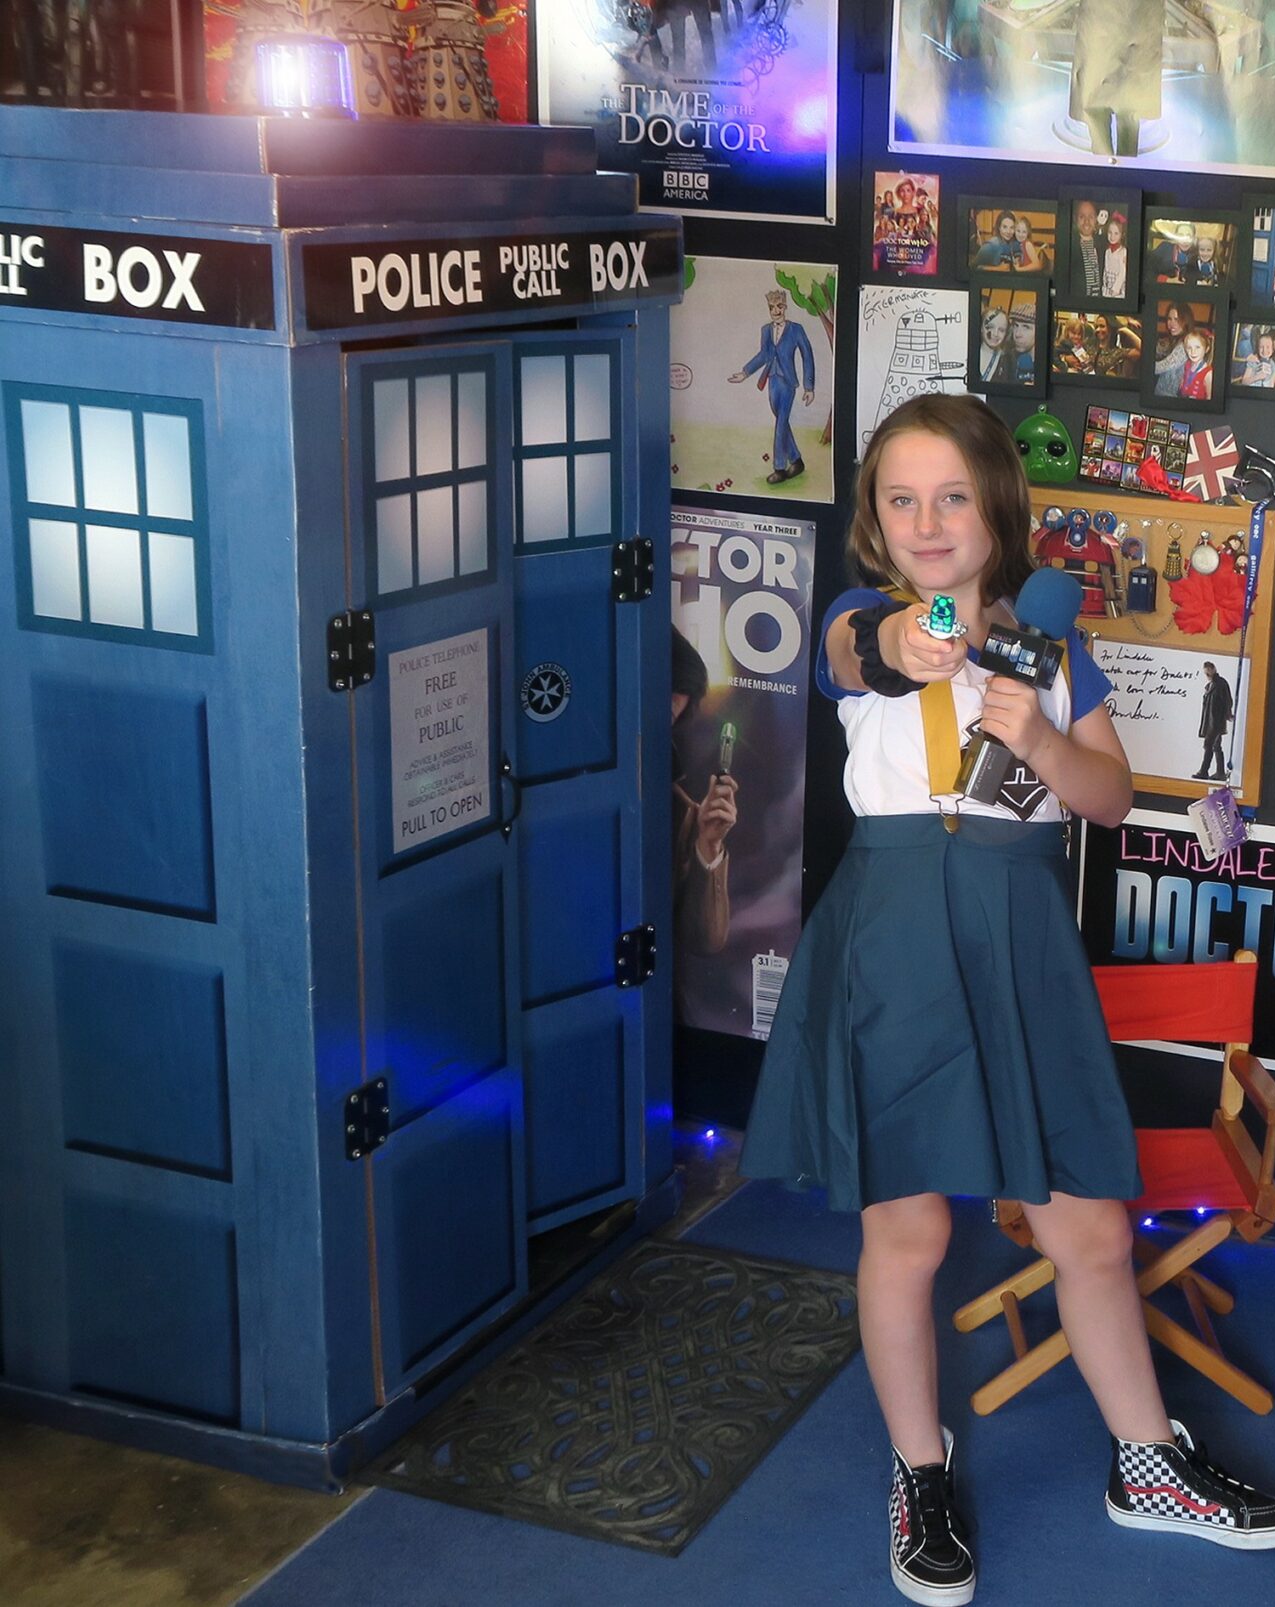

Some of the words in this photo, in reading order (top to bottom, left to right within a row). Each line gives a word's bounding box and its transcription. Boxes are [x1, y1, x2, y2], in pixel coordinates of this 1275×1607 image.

[602, 98, 624, 109] THE
[620, 83, 712, 120] TIME
[713, 103, 730, 115] OF
[732, 104, 756, 116] THE
[618, 113, 771, 153] DOCTOR
[664, 172, 708, 188] BBC
[663, 190, 708, 201] AMERICA
[499, 243, 570, 274] PUBLIC
[589, 241, 649, 292] BOX
[83, 243, 206, 312] BOX
[351, 250, 483, 314] POLICE
[513, 270, 562, 299] CALL
[699, 516, 745, 529] ADVENTURES
[753, 523, 774, 533] YEAR
[775, 526, 798, 536] THREE
[671, 581, 801, 690] HO
[400, 655, 430, 674] POLICE
[432, 641, 480, 664] TELEPHONE
[425, 671, 457, 695] FREE
[728, 676, 798, 695] REMEMBRANCE
[414, 706, 432, 720] FOR
[437, 698, 453, 712] USE
[457, 693, 469, 706] OF
[419, 714, 465, 743] PUBLIC
[409, 755, 432, 769] ADVICE
[402, 816, 427, 837] PULL
[430, 806, 447, 826] TO
[450, 792, 482, 818] OPEN
[758, 957, 769, 967] 3.1
